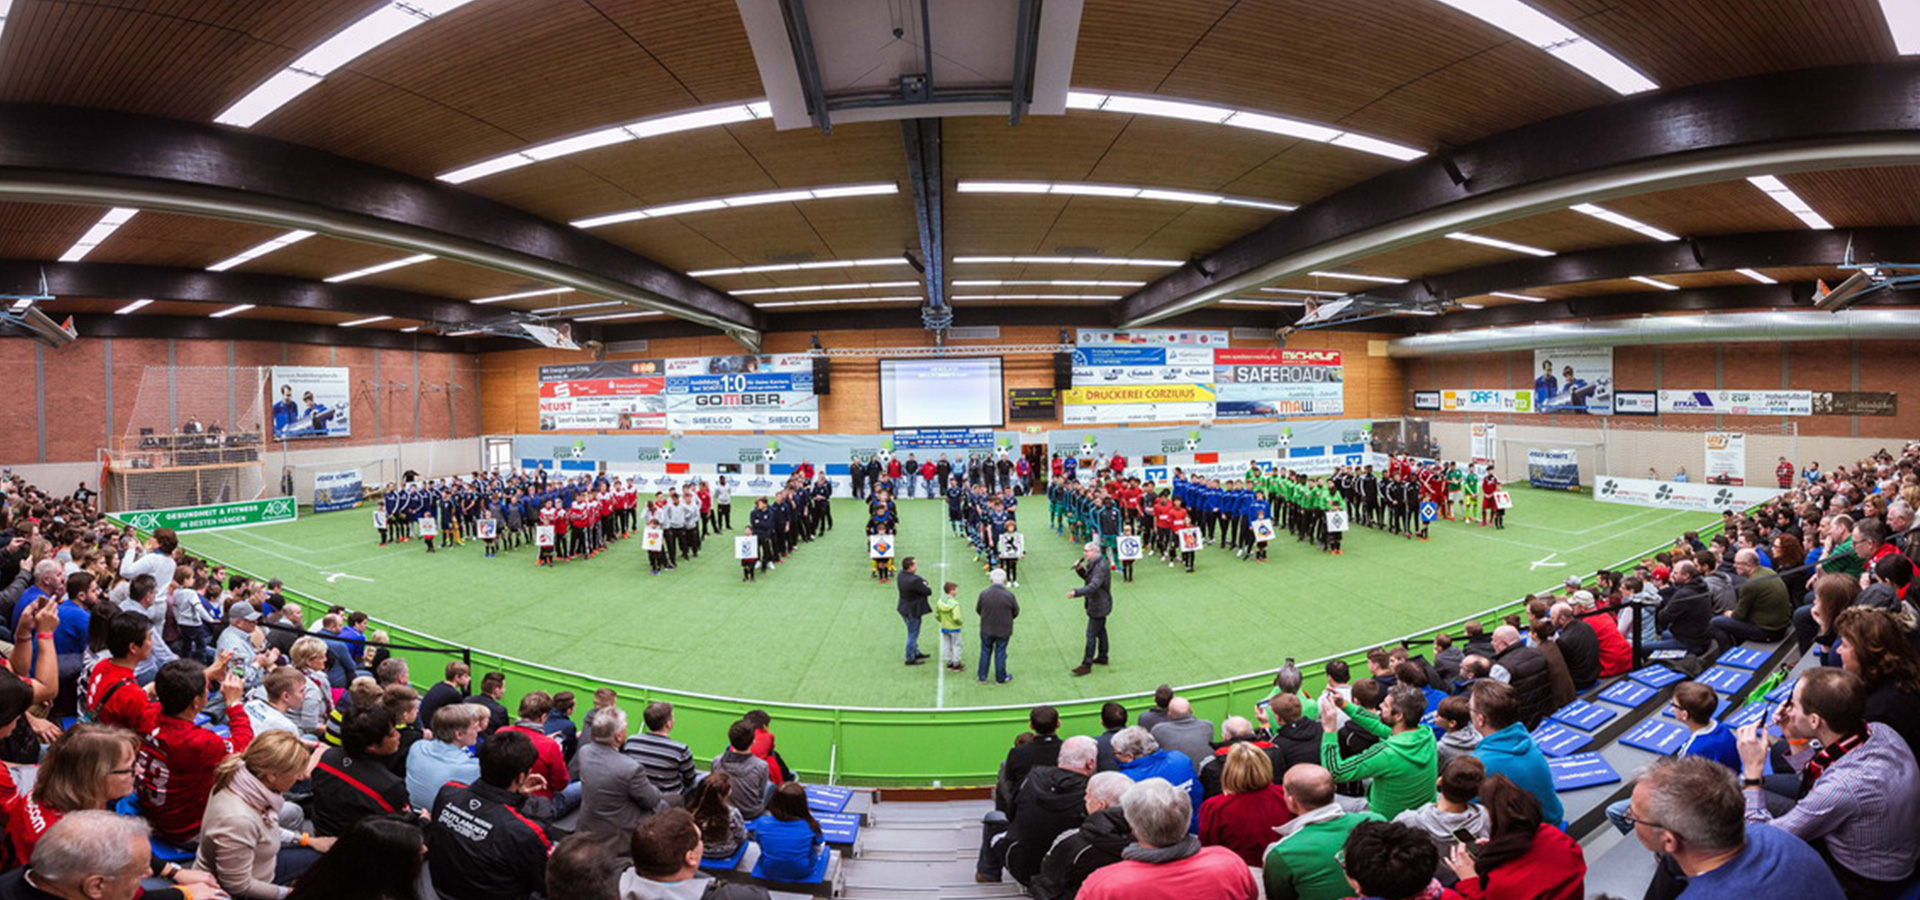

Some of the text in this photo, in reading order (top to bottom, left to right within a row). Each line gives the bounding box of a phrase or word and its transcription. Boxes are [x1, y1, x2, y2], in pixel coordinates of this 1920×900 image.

[721, 374, 747, 392] 1:0
[1085, 388, 1195, 400] DRUCKEREI CORZILIUS
[540, 402, 573, 411] NEUST
[692, 416, 733, 425] SIBELCO
[768, 415, 811, 425] SIBELCO
[1162, 444, 1185, 453] CUP
[739, 454, 763, 463] CUP
[165, 509, 217, 521] GESUNDHEIT
[227, 504, 259, 515] FITNESS
[180, 514, 247, 529] IN BESTEN HÄNDEN
